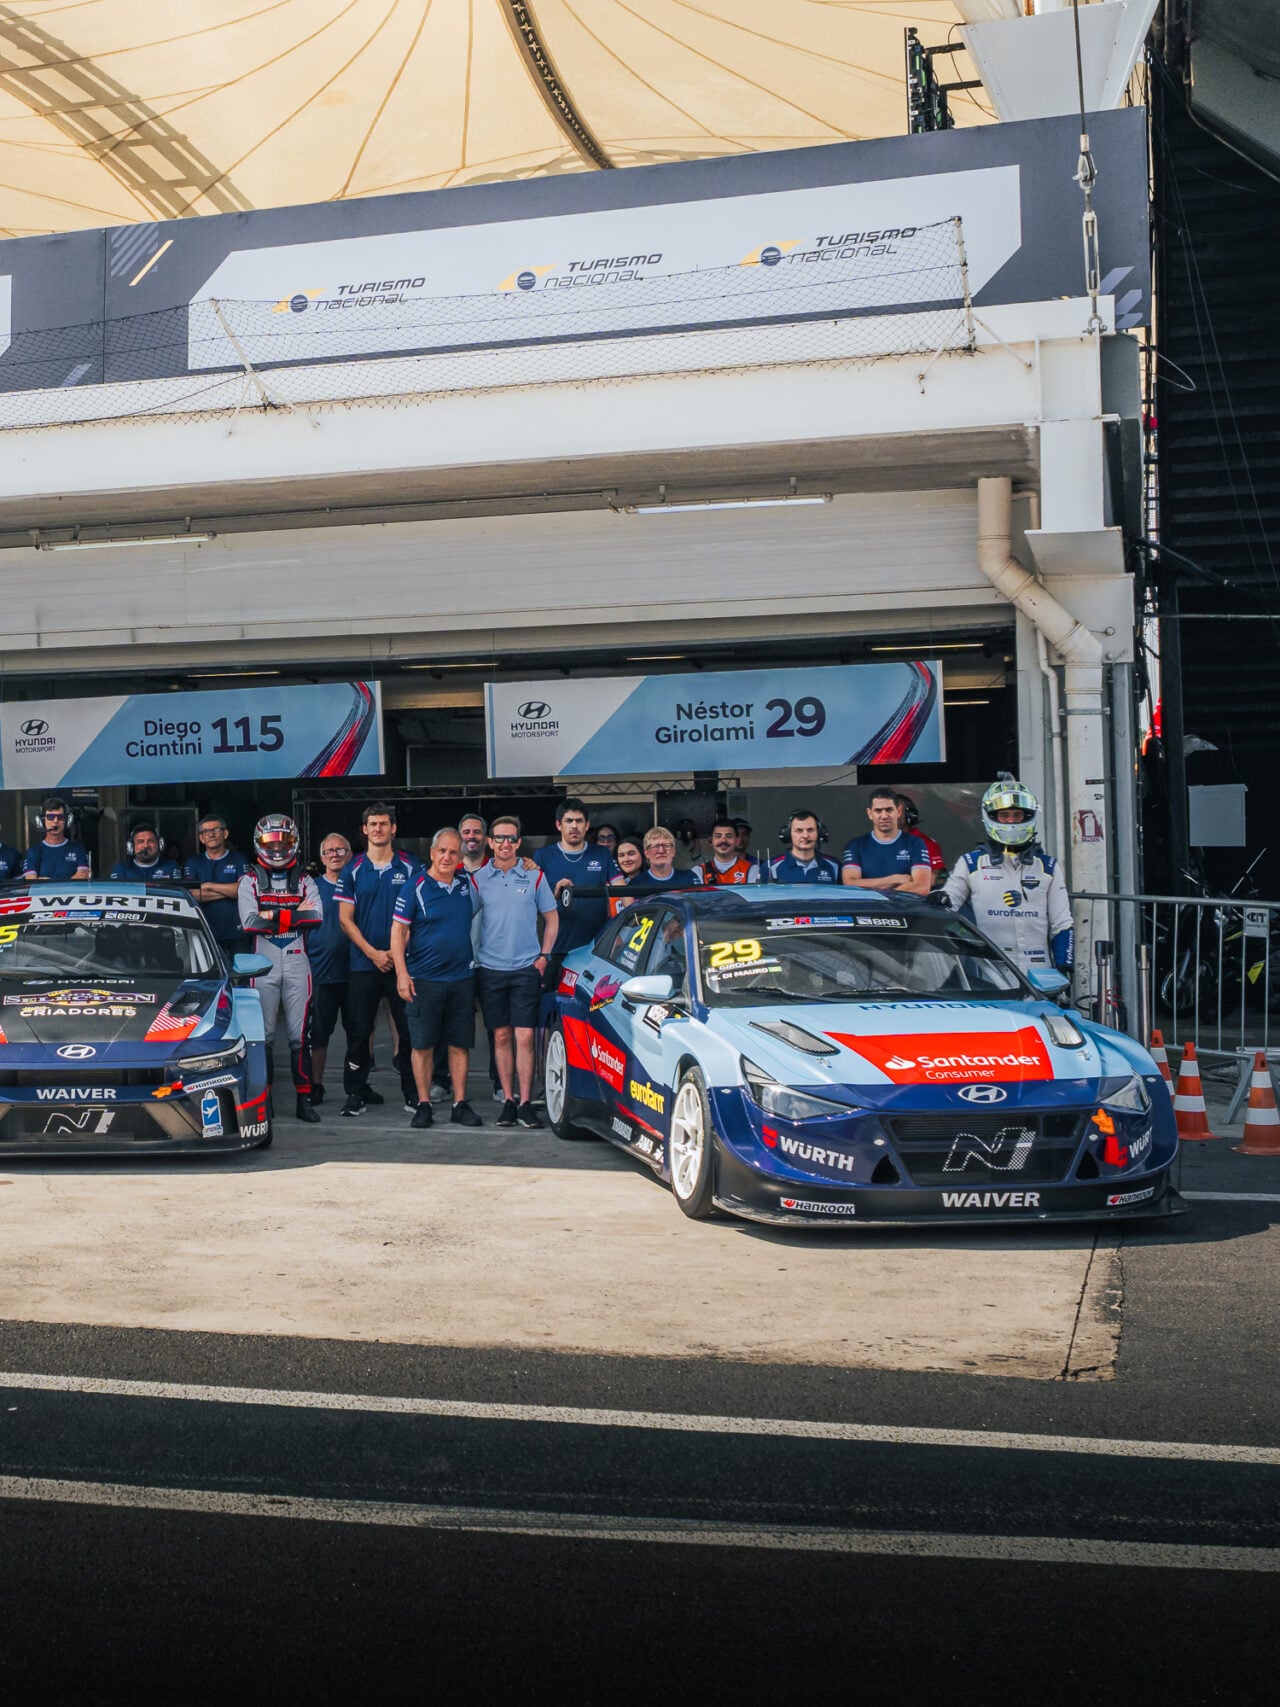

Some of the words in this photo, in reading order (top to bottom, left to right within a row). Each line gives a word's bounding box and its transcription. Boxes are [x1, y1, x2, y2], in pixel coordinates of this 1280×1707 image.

[815, 227, 917, 247] TURISMO
[568, 253, 662, 273] TURISMO
[338, 277, 425, 295] TURISMO
[543, 270, 644, 288] nacional
[676, 701, 754, 721] Néstor
[765, 697, 827, 739] 29
[511, 721, 559, 731] HYUNDAI
[655, 722, 755, 744] Girolami
[144, 720, 201, 743] Diego
[211, 715, 284, 753] 115
[511, 731, 559, 739] MOTORSPORT
[15, 737, 56, 746] HYUNDAI
[125, 738, 202, 758] Ciantini
[15, 745, 56, 754] MOTORSPORT
[38, 895, 181, 912] WÜRTH
[117, 912, 141, 920] BRB
[987, 908, 1039, 918] eurofarma
[765, 916, 812, 926] TCR
[871, 918, 901, 926] BRB
[710, 939, 762, 966] 29
[734, 967, 769, 977] MAURO
[20, 1008, 137, 1017] CRIADORES
[858, 1002, 999, 1010] HYUNDAI
[917, 1053, 1041, 1069] Santander
[925, 1069, 995, 1080] Consumer
[36, 1088, 116, 1100] WAIVER
[780, 1136, 854, 1172] WÜRTH
[941, 1192, 1041, 1208] WAIVER
